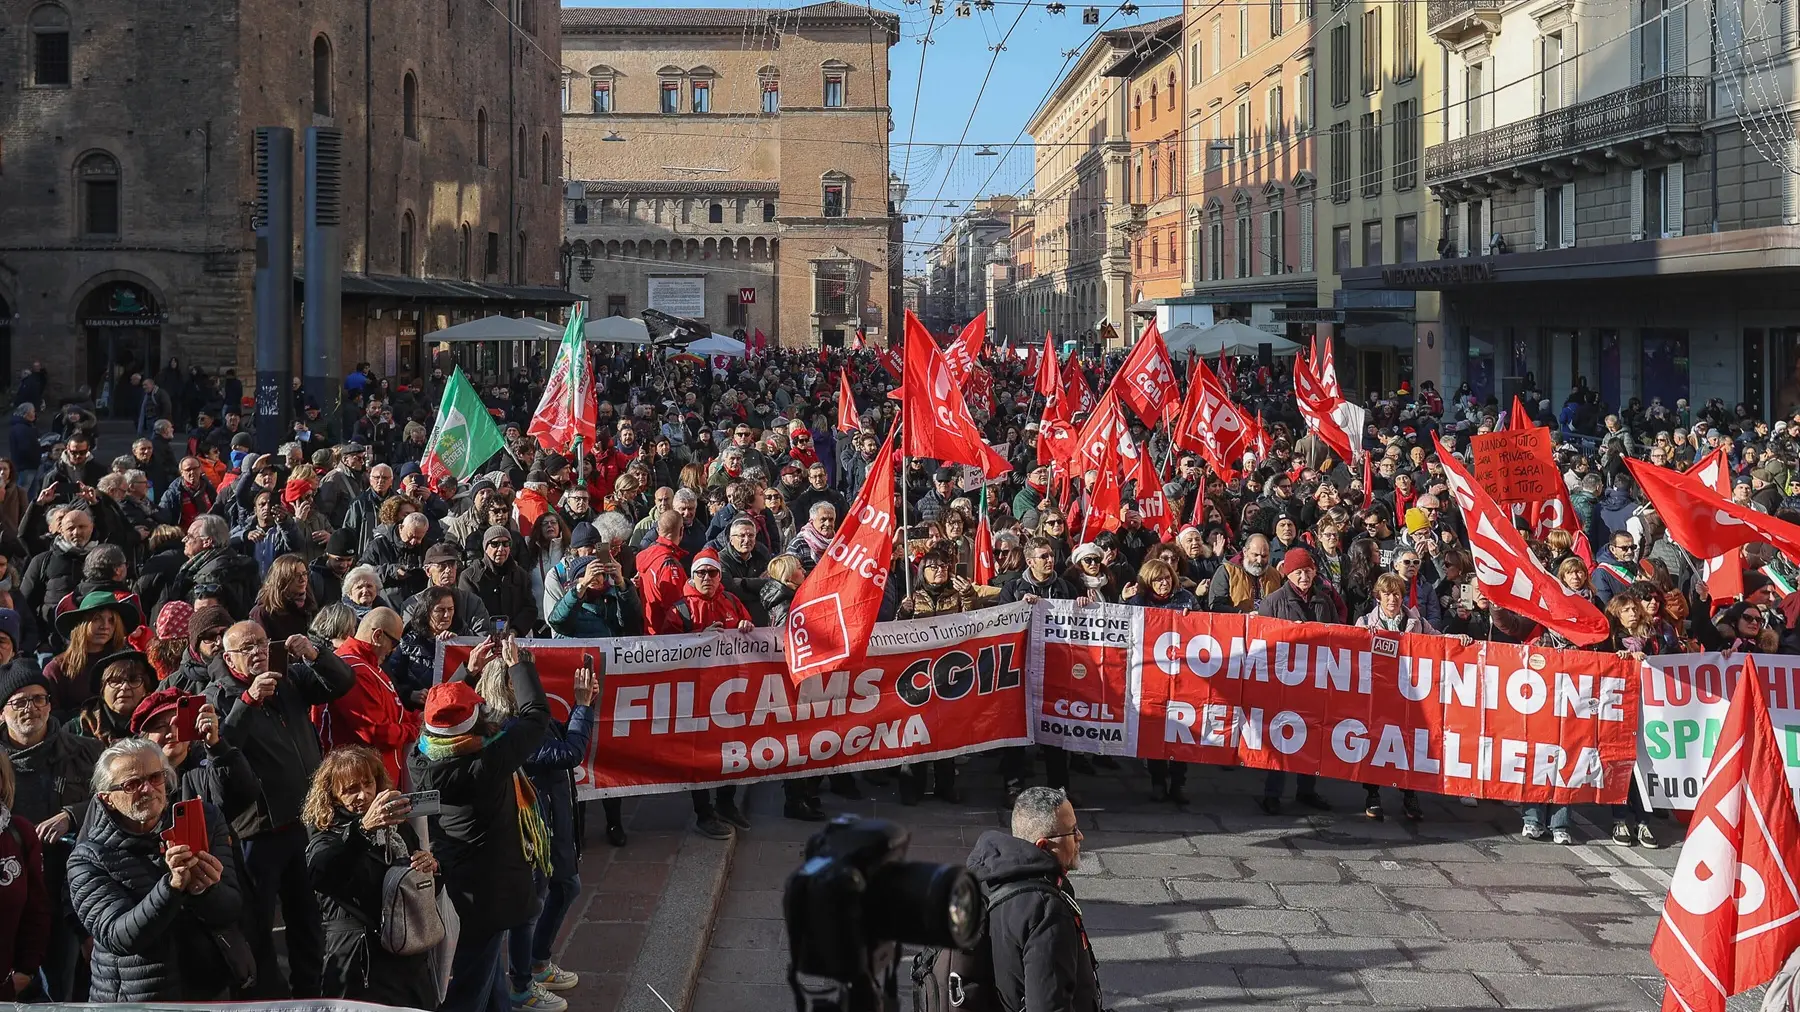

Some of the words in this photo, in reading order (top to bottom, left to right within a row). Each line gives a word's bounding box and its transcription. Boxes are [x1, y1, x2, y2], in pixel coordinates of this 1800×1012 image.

[929, 5, 943, 15] 15
[955, 6, 971, 17] 14
[1084, 13, 1099, 23] 13
[741, 291, 754, 301] W
[1136, 372, 1162, 403] CGIL
[1511, 433, 1538, 449] TUTTO
[1499, 450, 1534, 464] PRIVATO
[1498, 467, 1510, 478] TU
[1512, 464, 1544, 476] SARAI
[1515, 480, 1543, 493] TUTTO
[1045, 615, 1129, 630] FUNZIONE
[614, 644, 712, 664] Federazione
[715, 636, 769, 657] Italiana
[933, 621, 984, 641] Turismo
[792, 612, 813, 667] CGIL
[1044, 628, 1127, 643] PUBBLICA
[1374, 639, 1396, 652] AGD
[1153, 631, 1372, 694] COMUNI
[1398, 655, 1626, 722] UNIONE
[612, 668, 885, 738] FILCAMS
[896, 643, 1021, 707] CGIL
[1054, 699, 1114, 719] CGIL
[1041, 721, 1122, 741] BOLOGNA
[721, 714, 931, 775] BOLOGNA
[1164, 700, 1307, 755] RENO
[1331, 718, 1604, 789] GALLIERA
